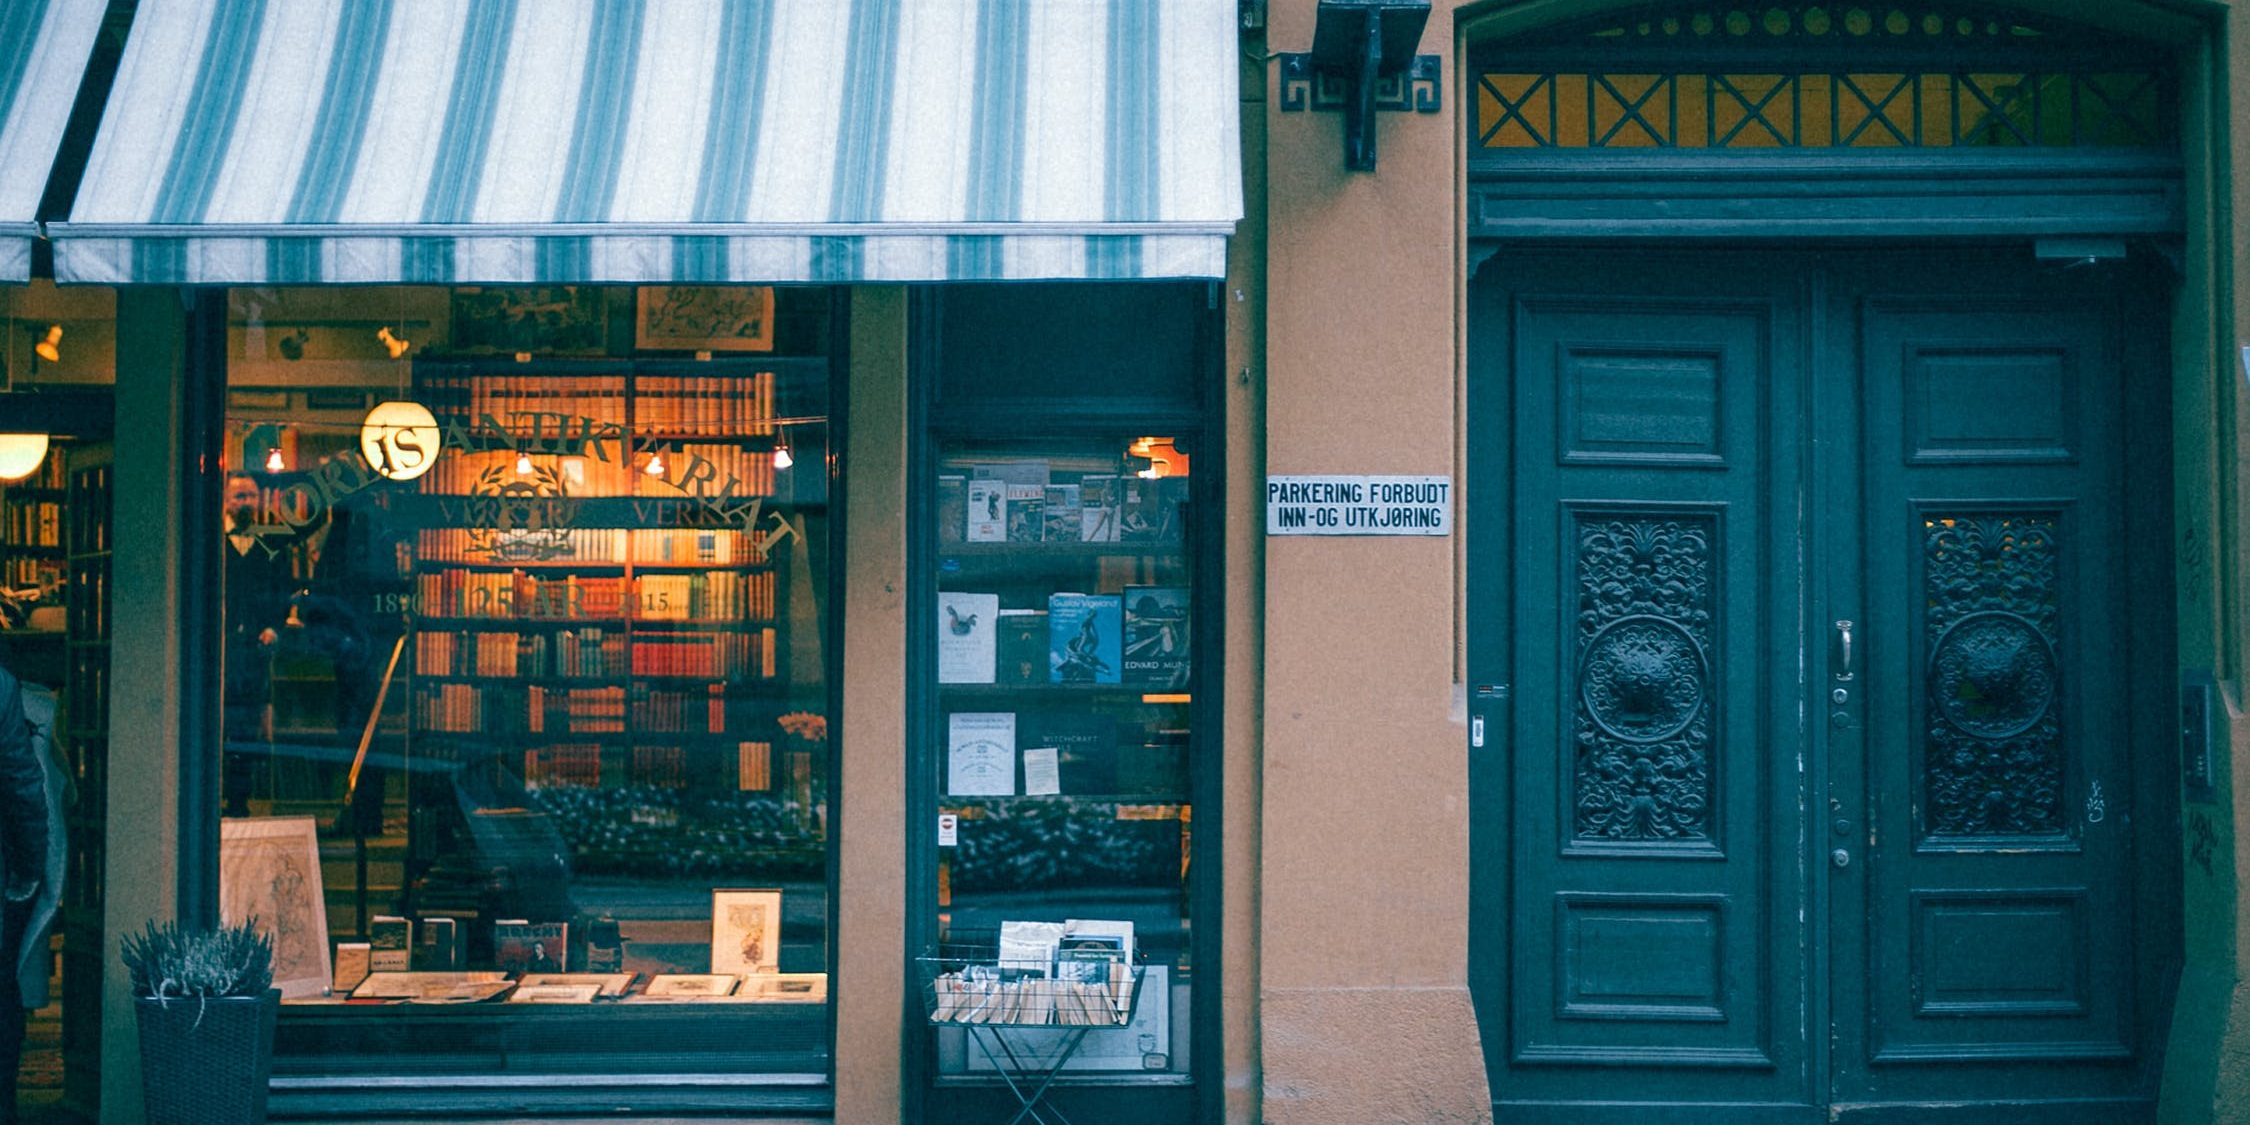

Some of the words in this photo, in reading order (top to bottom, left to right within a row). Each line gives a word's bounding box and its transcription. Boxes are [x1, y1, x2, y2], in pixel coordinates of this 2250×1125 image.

[438, 411, 801, 559] ANTIKVARIAT
[1268, 484, 1362, 503] PARKERING
[1370, 484, 1448, 503] FORBUDT
[1345, 507, 1441, 527] UTKJØRING
[1125, 661, 1159, 670] EDVARD
